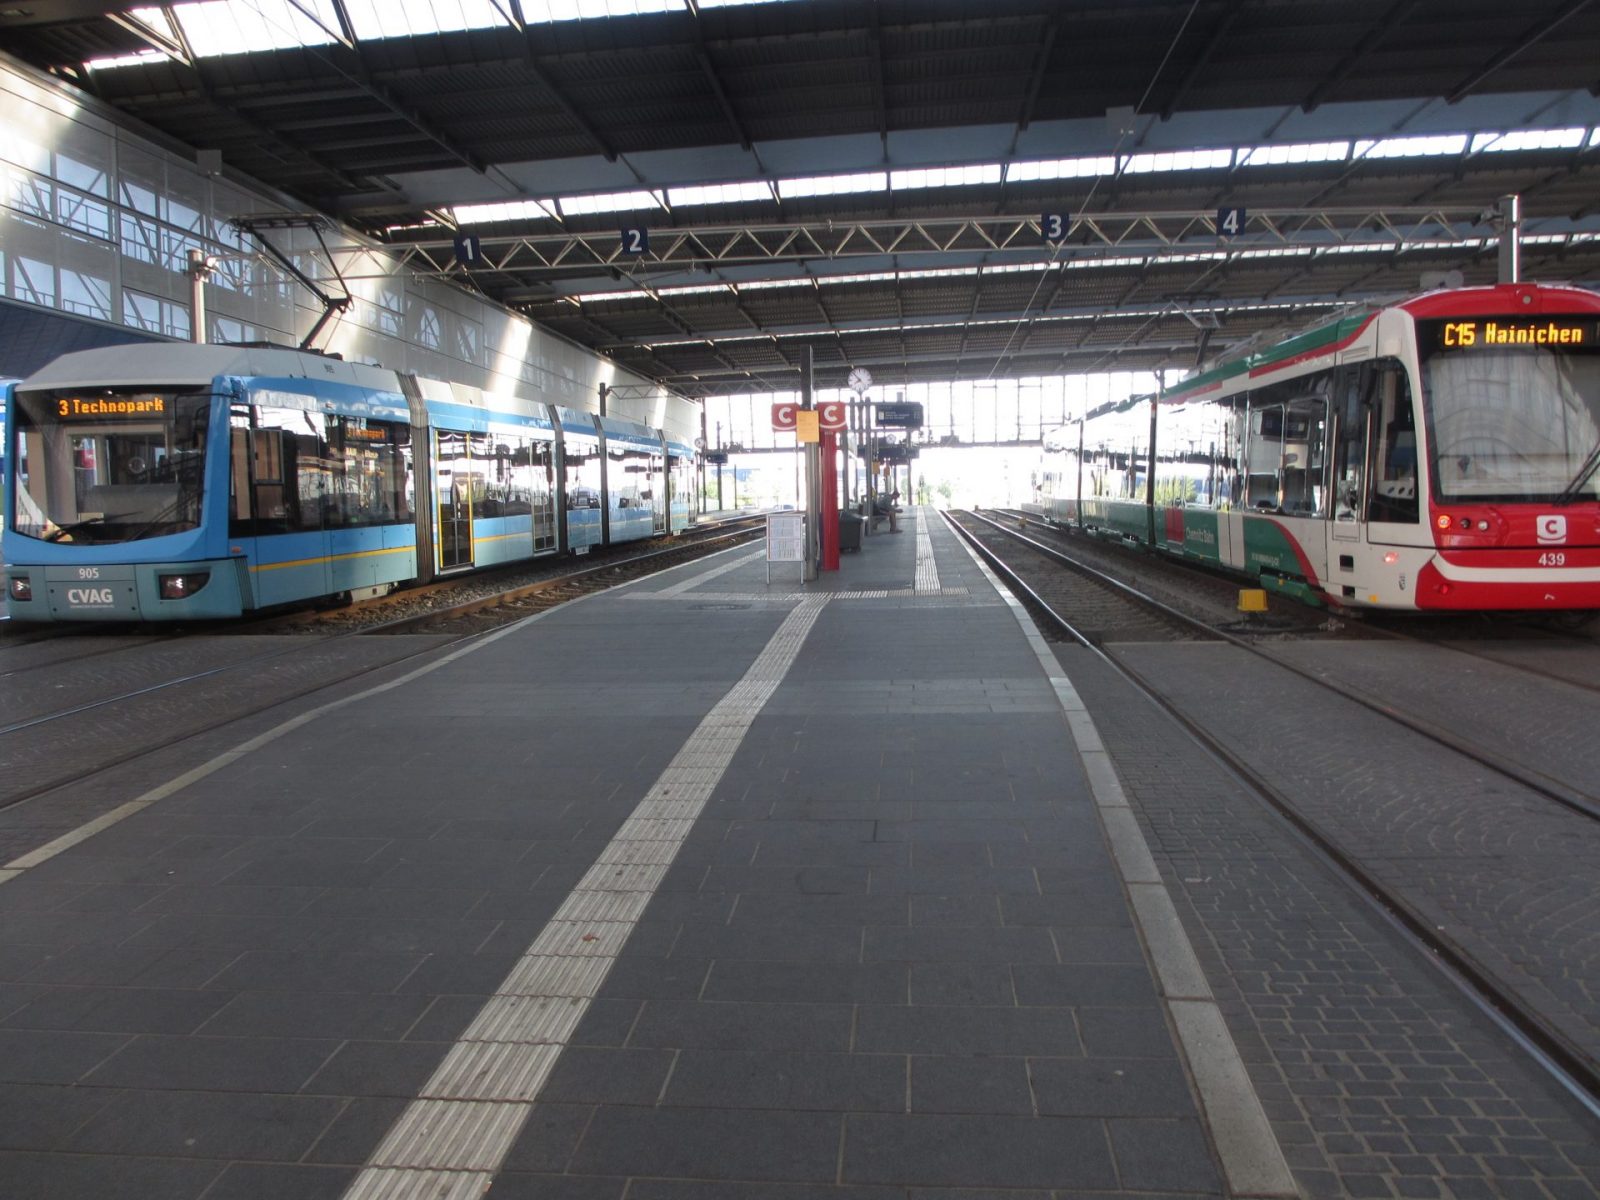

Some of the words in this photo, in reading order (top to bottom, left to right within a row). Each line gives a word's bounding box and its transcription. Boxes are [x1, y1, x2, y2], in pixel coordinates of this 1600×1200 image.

[1048, 214, 1062, 238] 3
[1223, 209, 1239, 234] 4
[462, 238, 474, 260] 1
[628, 229, 643, 252] 2
[1444, 323, 1475, 346] C15
[1485, 323, 1583, 344] Hainichen
[59, 399, 69, 416] 3
[73, 397, 164, 414] Technopark
[778, 407, 792, 424] C
[823, 405, 838, 422] C
[1545, 520, 1558, 535] C
[1538, 552, 1565, 566] 439
[79, 567, 99, 579] 905
[68, 588, 113, 604] CVAG
